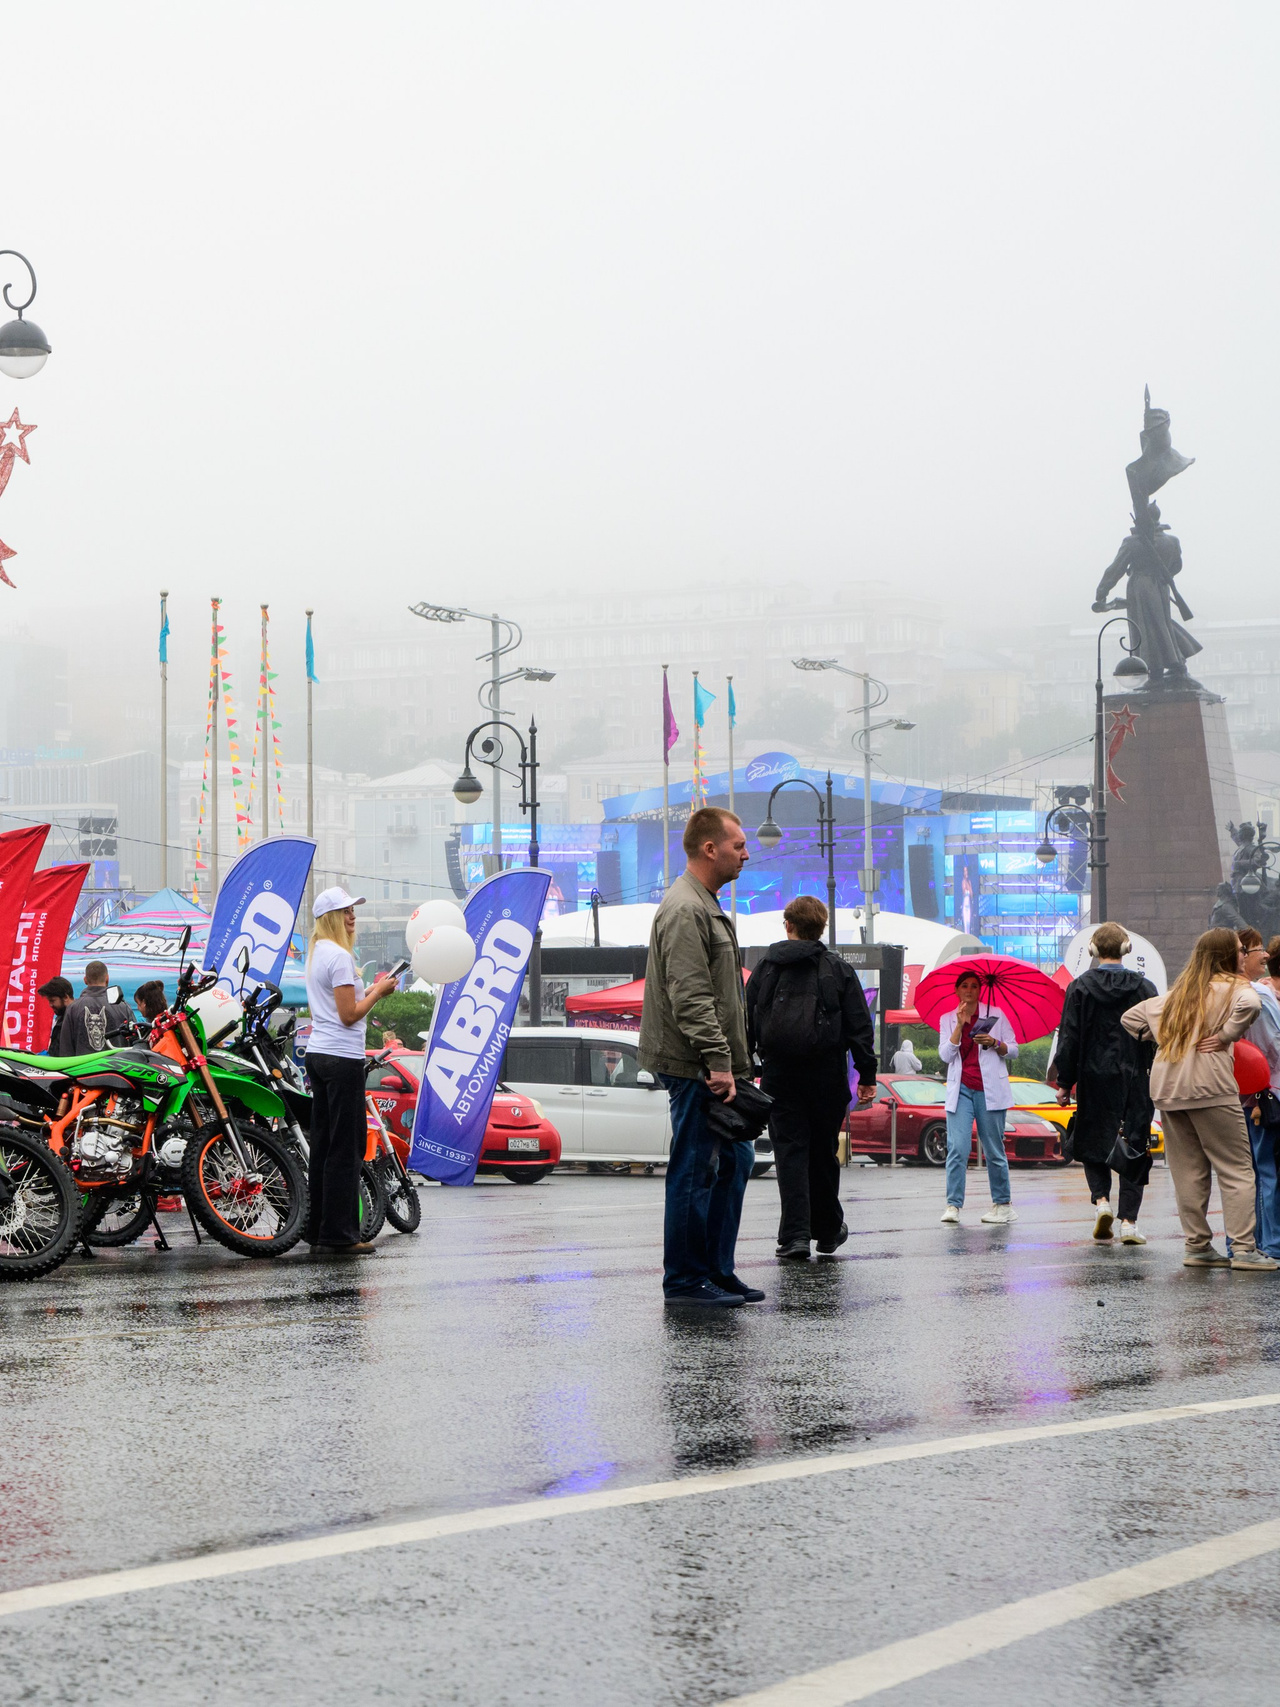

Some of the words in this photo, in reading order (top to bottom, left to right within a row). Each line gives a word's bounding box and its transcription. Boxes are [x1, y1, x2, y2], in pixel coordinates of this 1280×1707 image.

[31, 912, 48, 962] ЯПОНИЯ
[219, 927, 232, 950] NAME
[229, 881, 255, 926] WORLDWIDE
[474, 909, 494, 945] ORLDWIDE
[83, 932, 181, 957] ABRO
[25, 969, 38, 1052] АВТОТОВАРЫ
[426, 919, 534, 1111] ABRO
[24, 1067, 47, 1076] MAX
[98, 1061, 157, 1078] SPR
[452, 1022, 511, 1126] АВТОХИМИЯ
[445, 1150, 466, 1162] 1939
